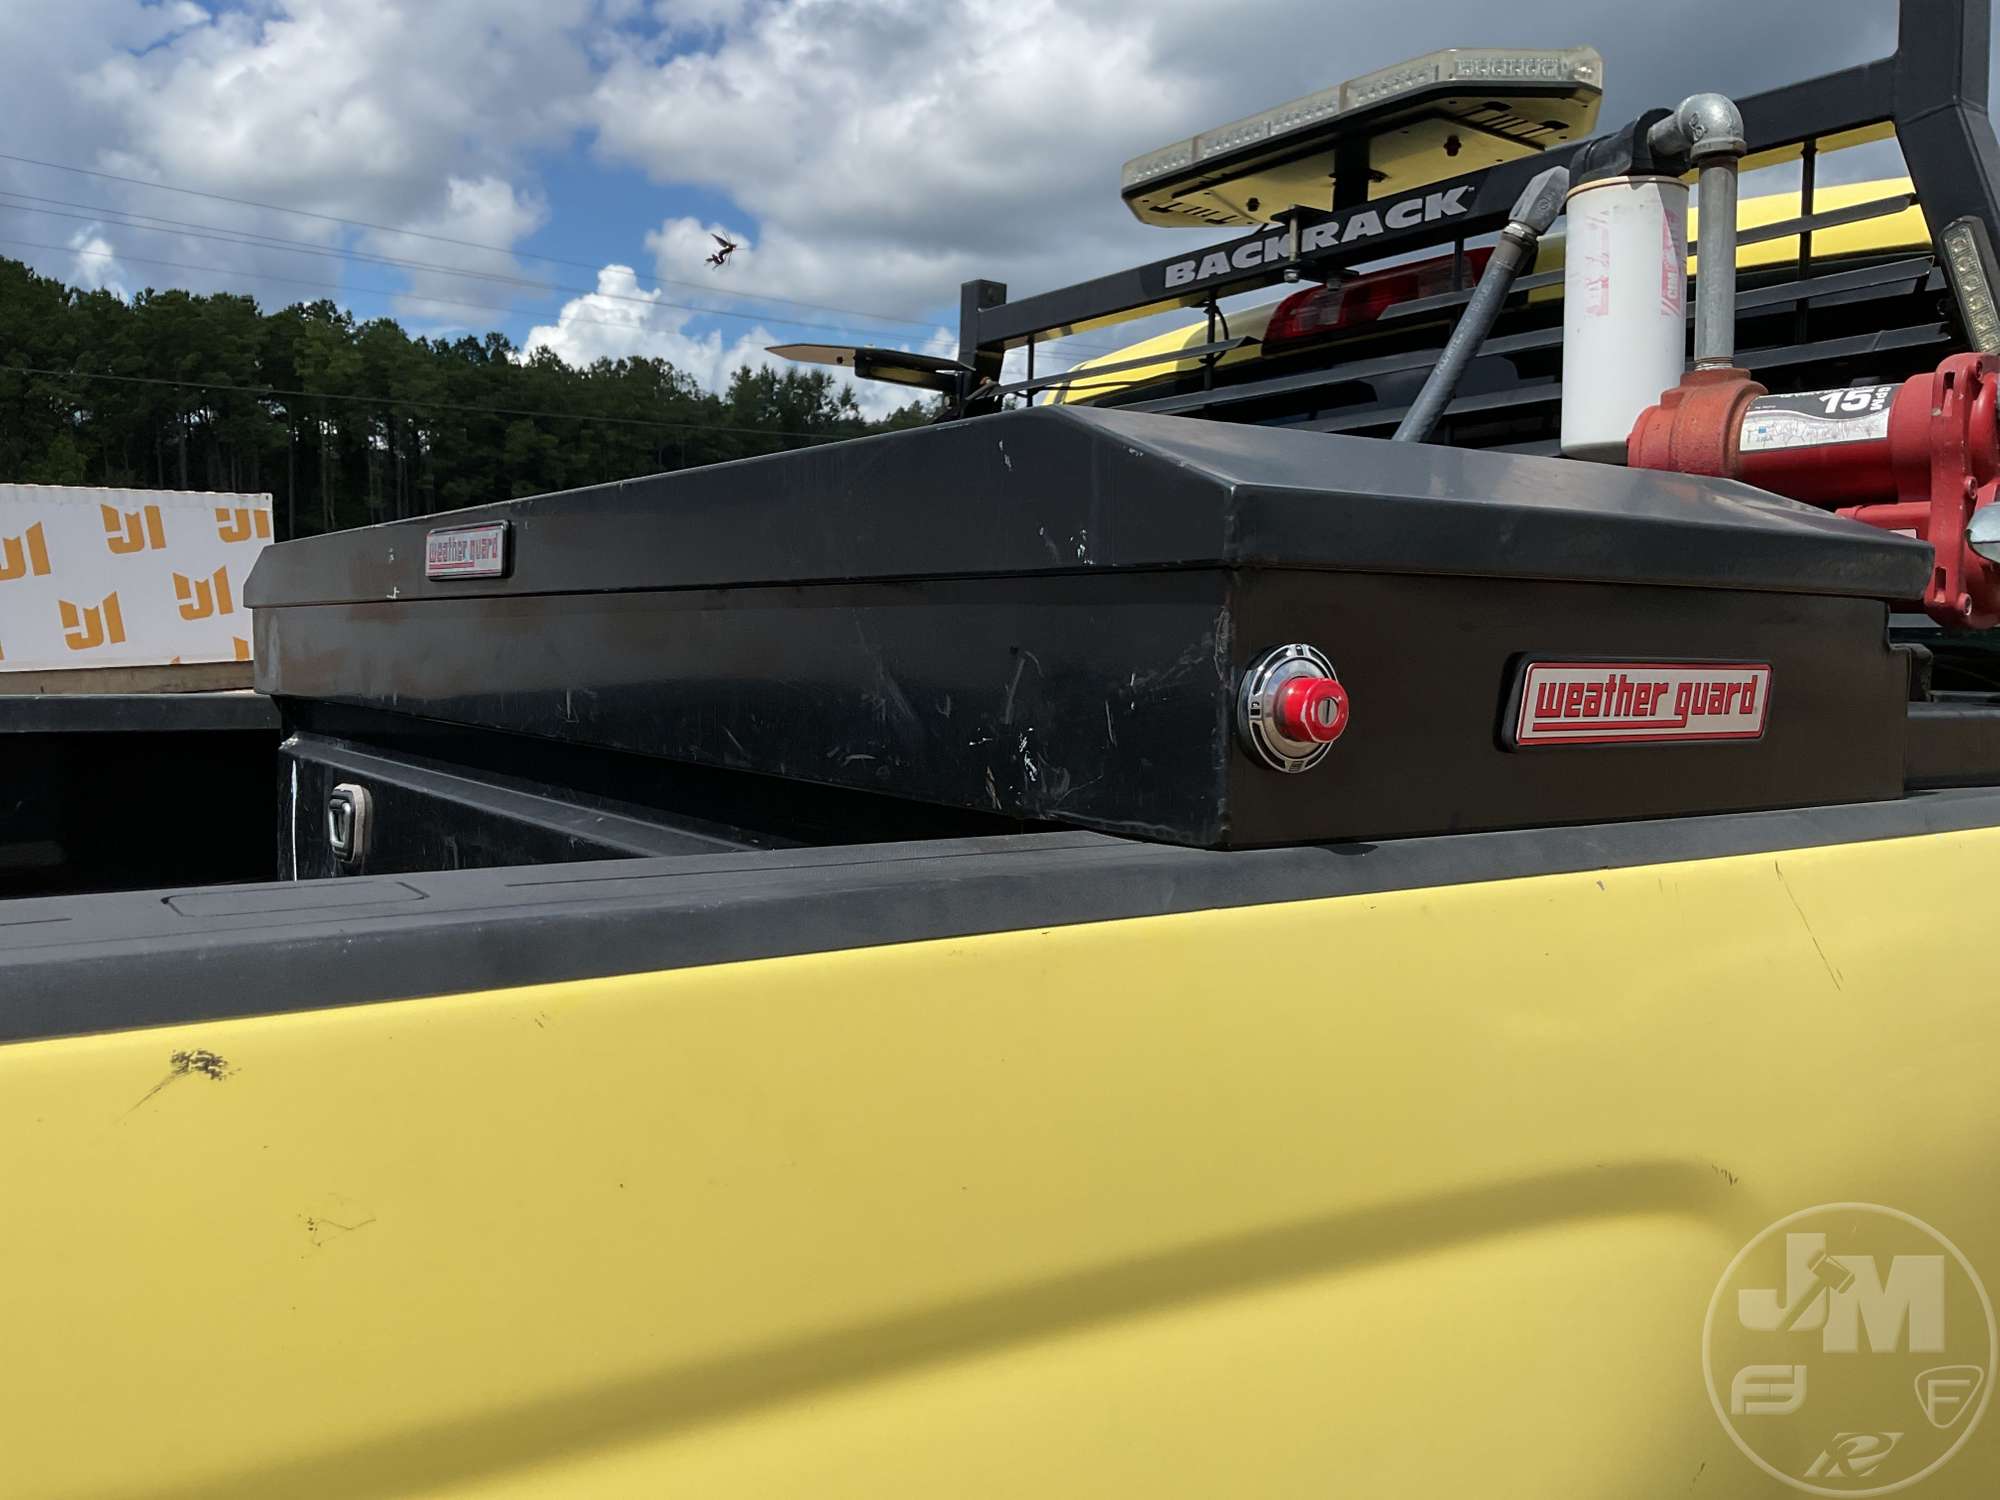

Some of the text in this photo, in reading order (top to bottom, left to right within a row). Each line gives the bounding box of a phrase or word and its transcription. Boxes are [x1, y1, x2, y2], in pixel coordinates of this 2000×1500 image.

[1164, 185, 1469, 289] BACKRACK
[1819, 388, 1875, 414] 15
[1534, 674, 1759, 728] weather guard
